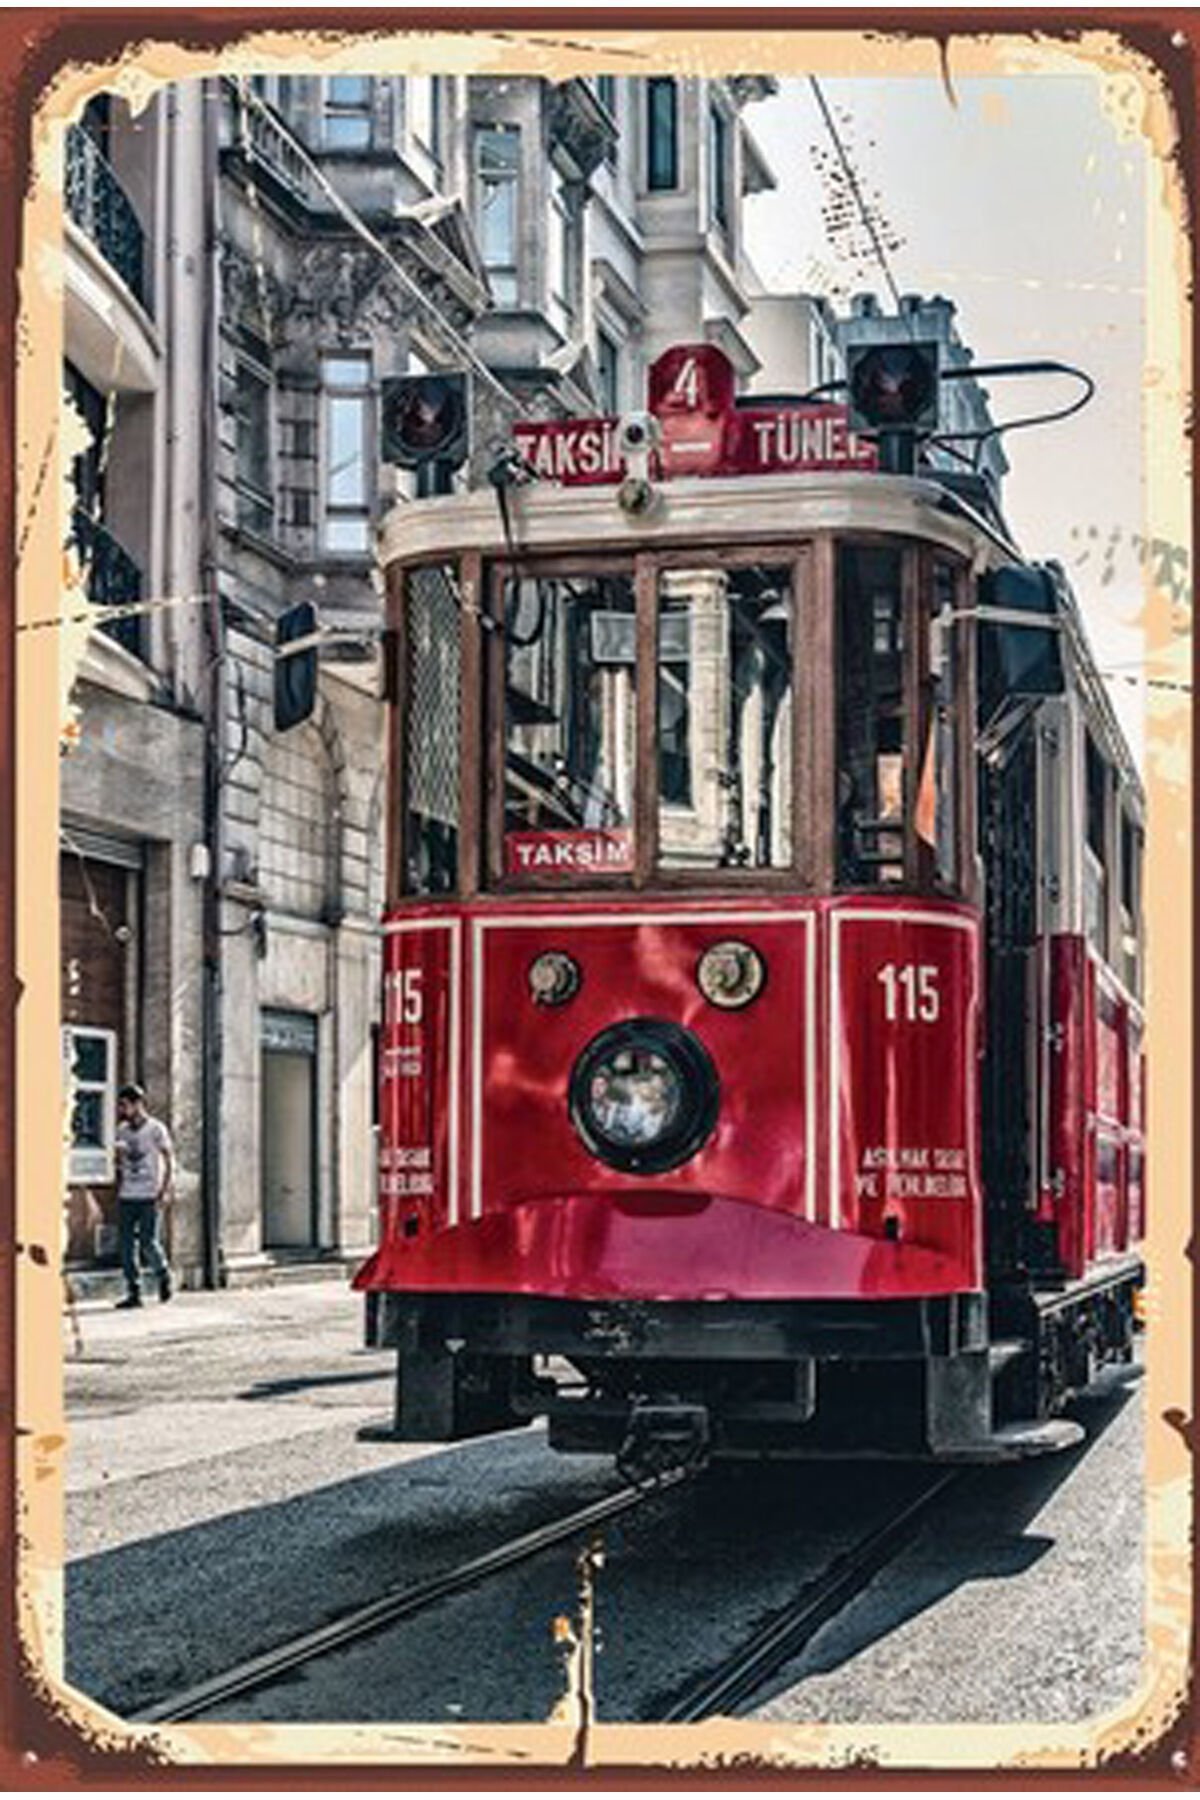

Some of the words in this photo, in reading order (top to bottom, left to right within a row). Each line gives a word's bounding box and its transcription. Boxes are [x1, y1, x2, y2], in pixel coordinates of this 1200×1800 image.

[674, 358, 698, 407] 4
[515, 422, 622, 475] TAKSİ
[877, 964, 939, 1022] 115
